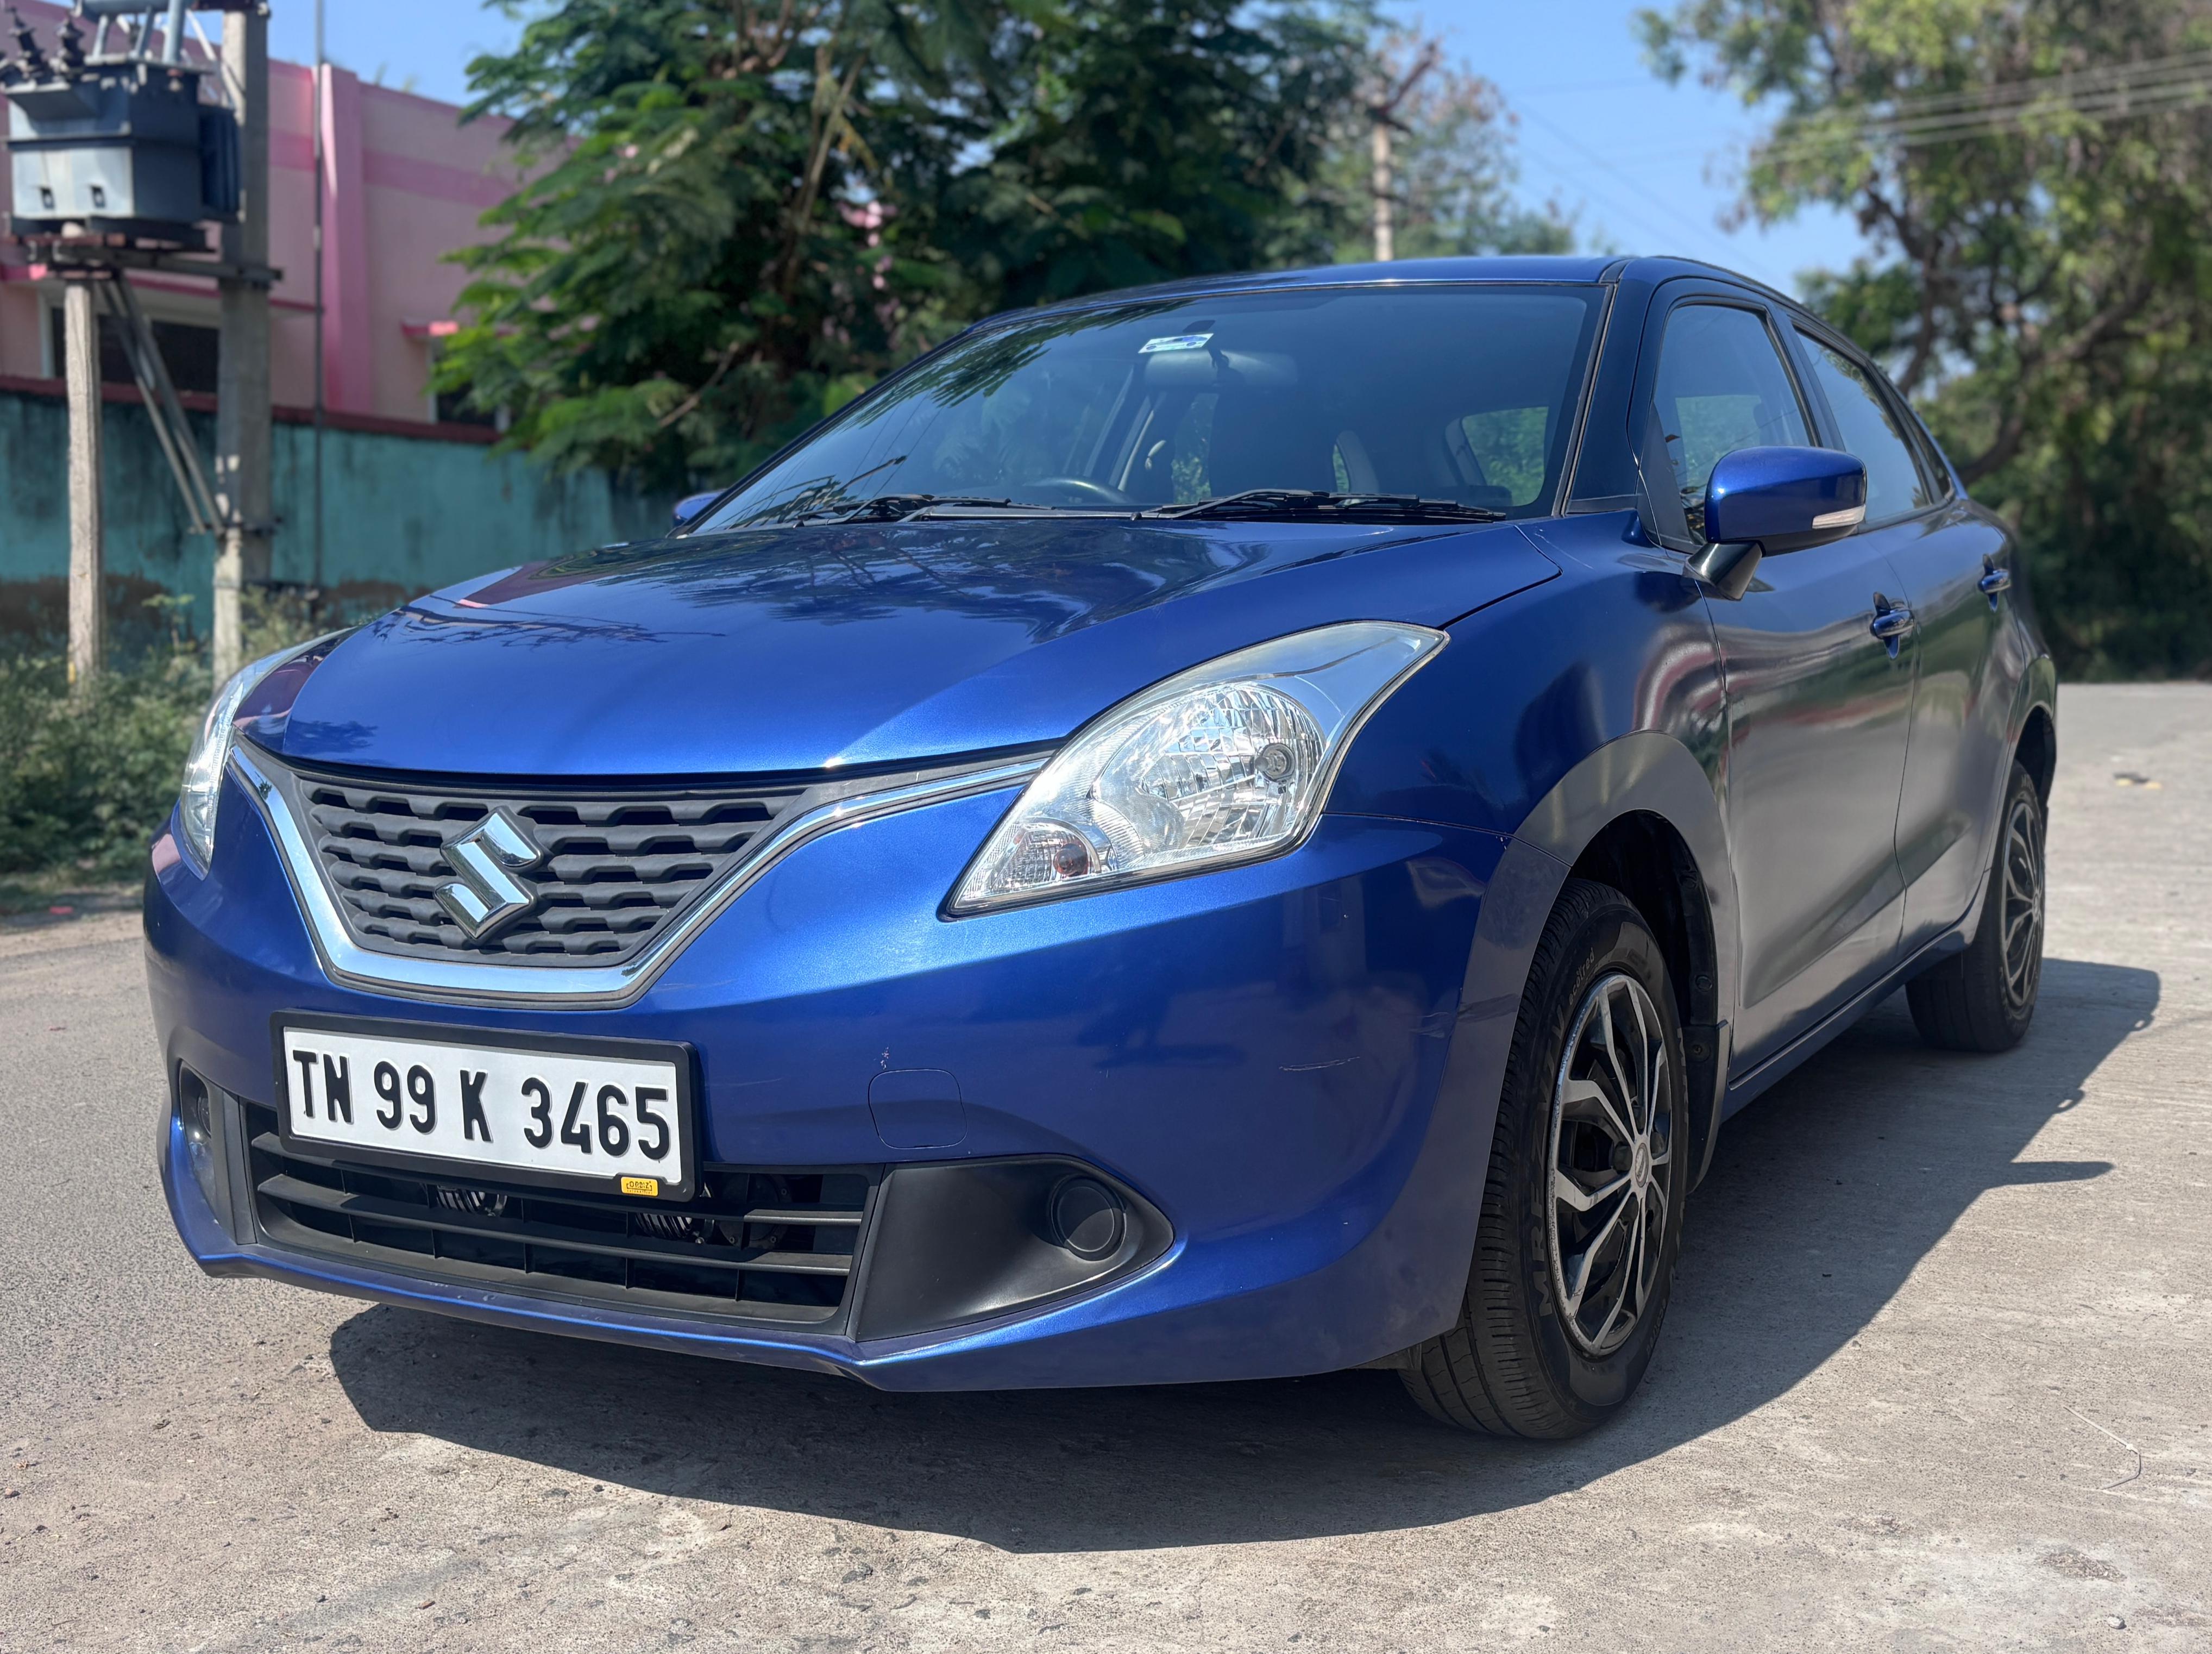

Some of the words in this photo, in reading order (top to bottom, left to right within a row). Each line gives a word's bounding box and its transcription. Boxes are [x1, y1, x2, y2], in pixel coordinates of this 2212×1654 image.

[293, 1050, 350, 1124] TN
[374, 1061, 436, 1134] 99
[460, 1069, 492, 1142] K
[521, 1077, 670, 1161] 3465
[1530, 1181, 1553, 1317] MRF
